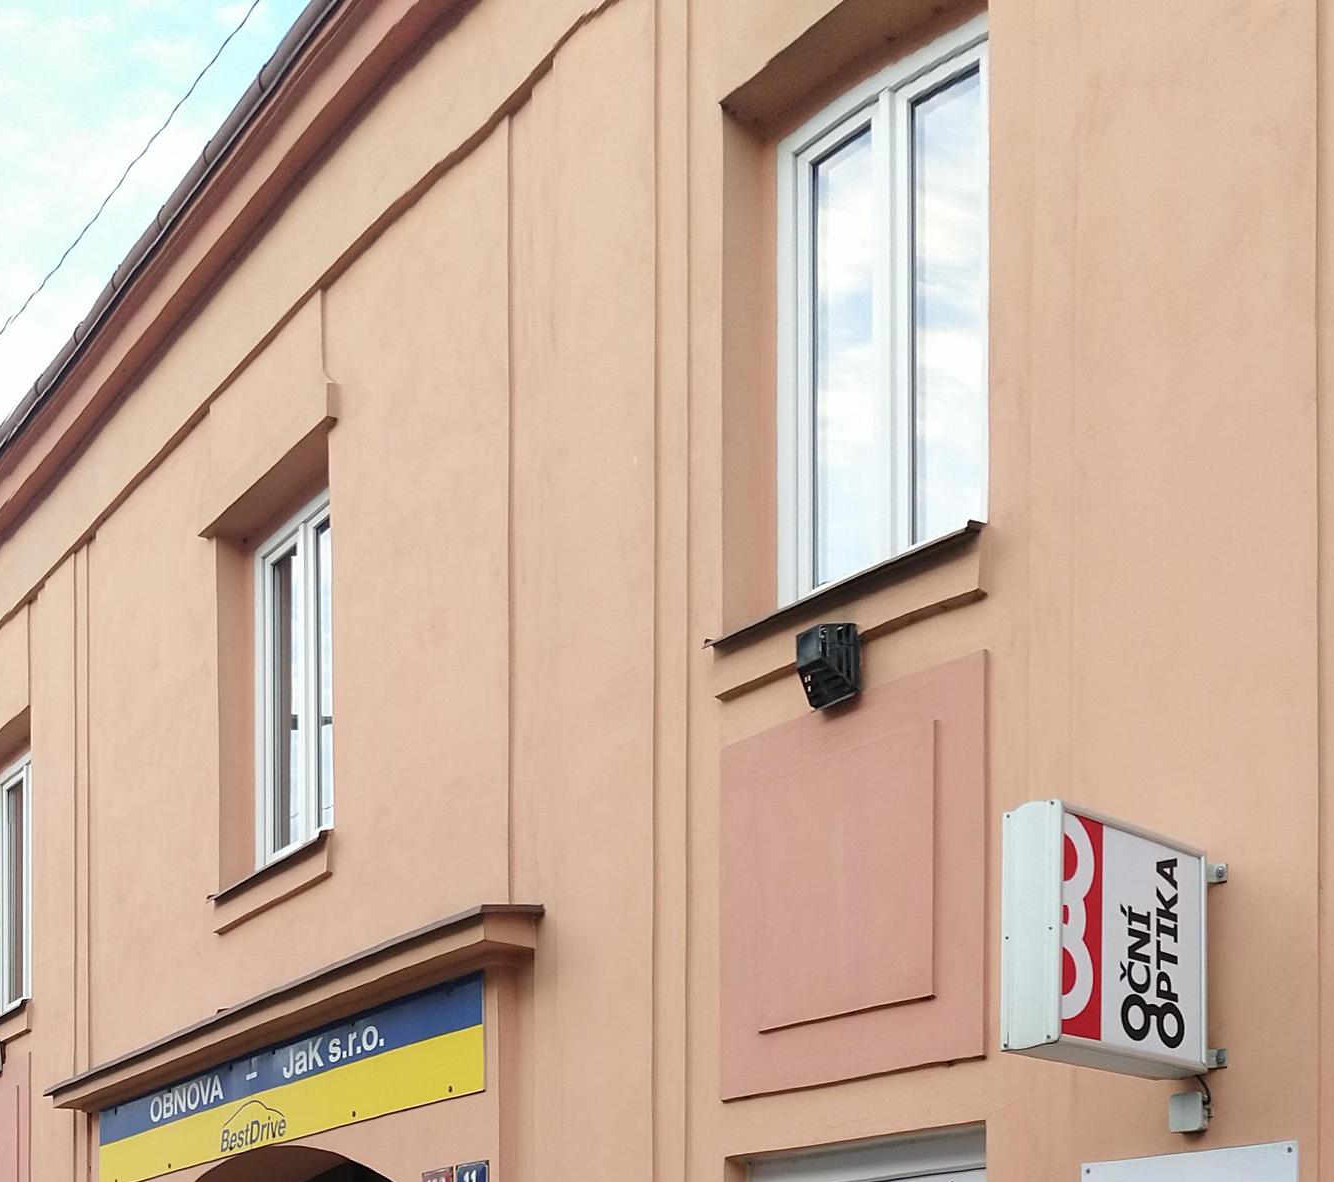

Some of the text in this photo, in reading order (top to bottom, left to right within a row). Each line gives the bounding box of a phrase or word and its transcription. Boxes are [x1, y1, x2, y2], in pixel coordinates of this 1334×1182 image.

[1120, 904, 1151, 1042] OČNÍ
[1156, 858, 1185, 1049] OPTIKA
[149, 1074, 224, 1123] OBNOVA
[282, 1036, 324, 1079] JaK
[328, 1025, 386, 1063] s.r.o.
[220, 1116, 286, 1152] BestDrive
